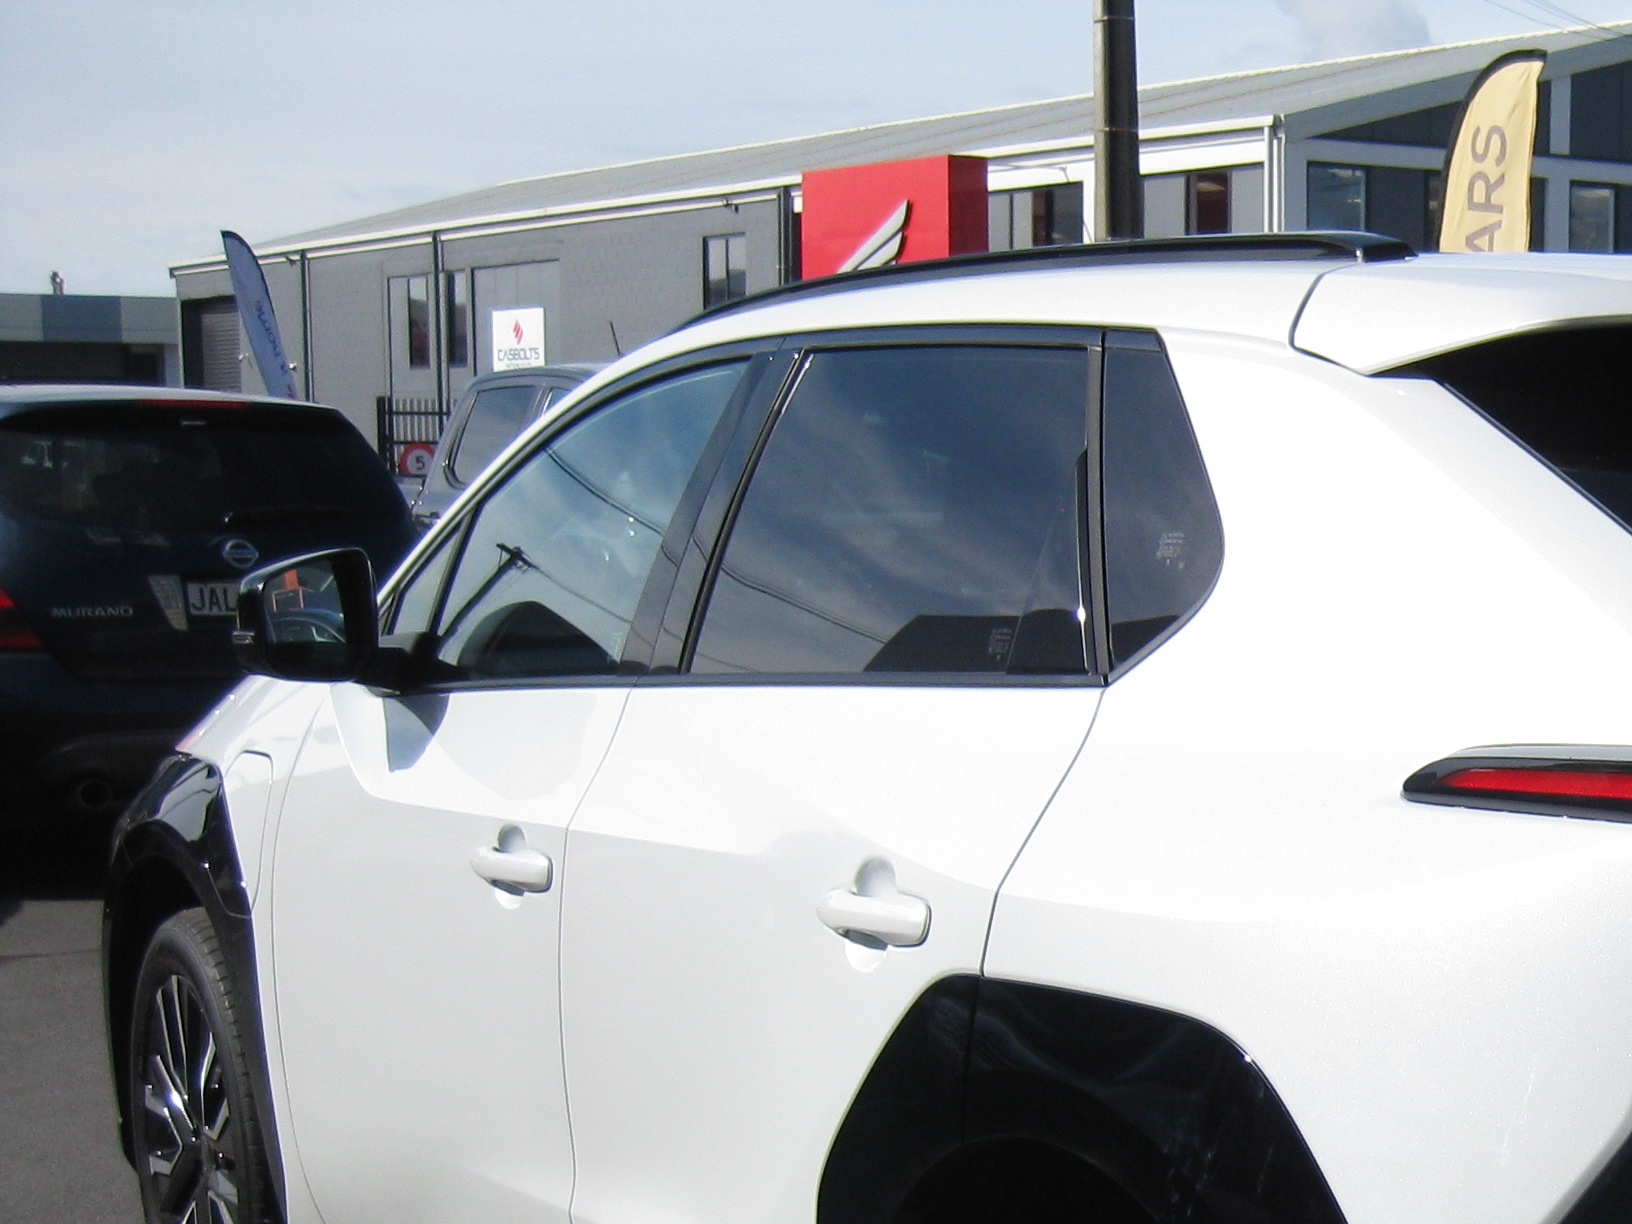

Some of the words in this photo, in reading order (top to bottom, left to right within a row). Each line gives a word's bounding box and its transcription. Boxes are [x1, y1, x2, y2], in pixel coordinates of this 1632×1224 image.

[497, 347, 540, 362] CASBOLTS
[415, 455, 425, 470] 5
[52, 604, 134, 618] MURANO
